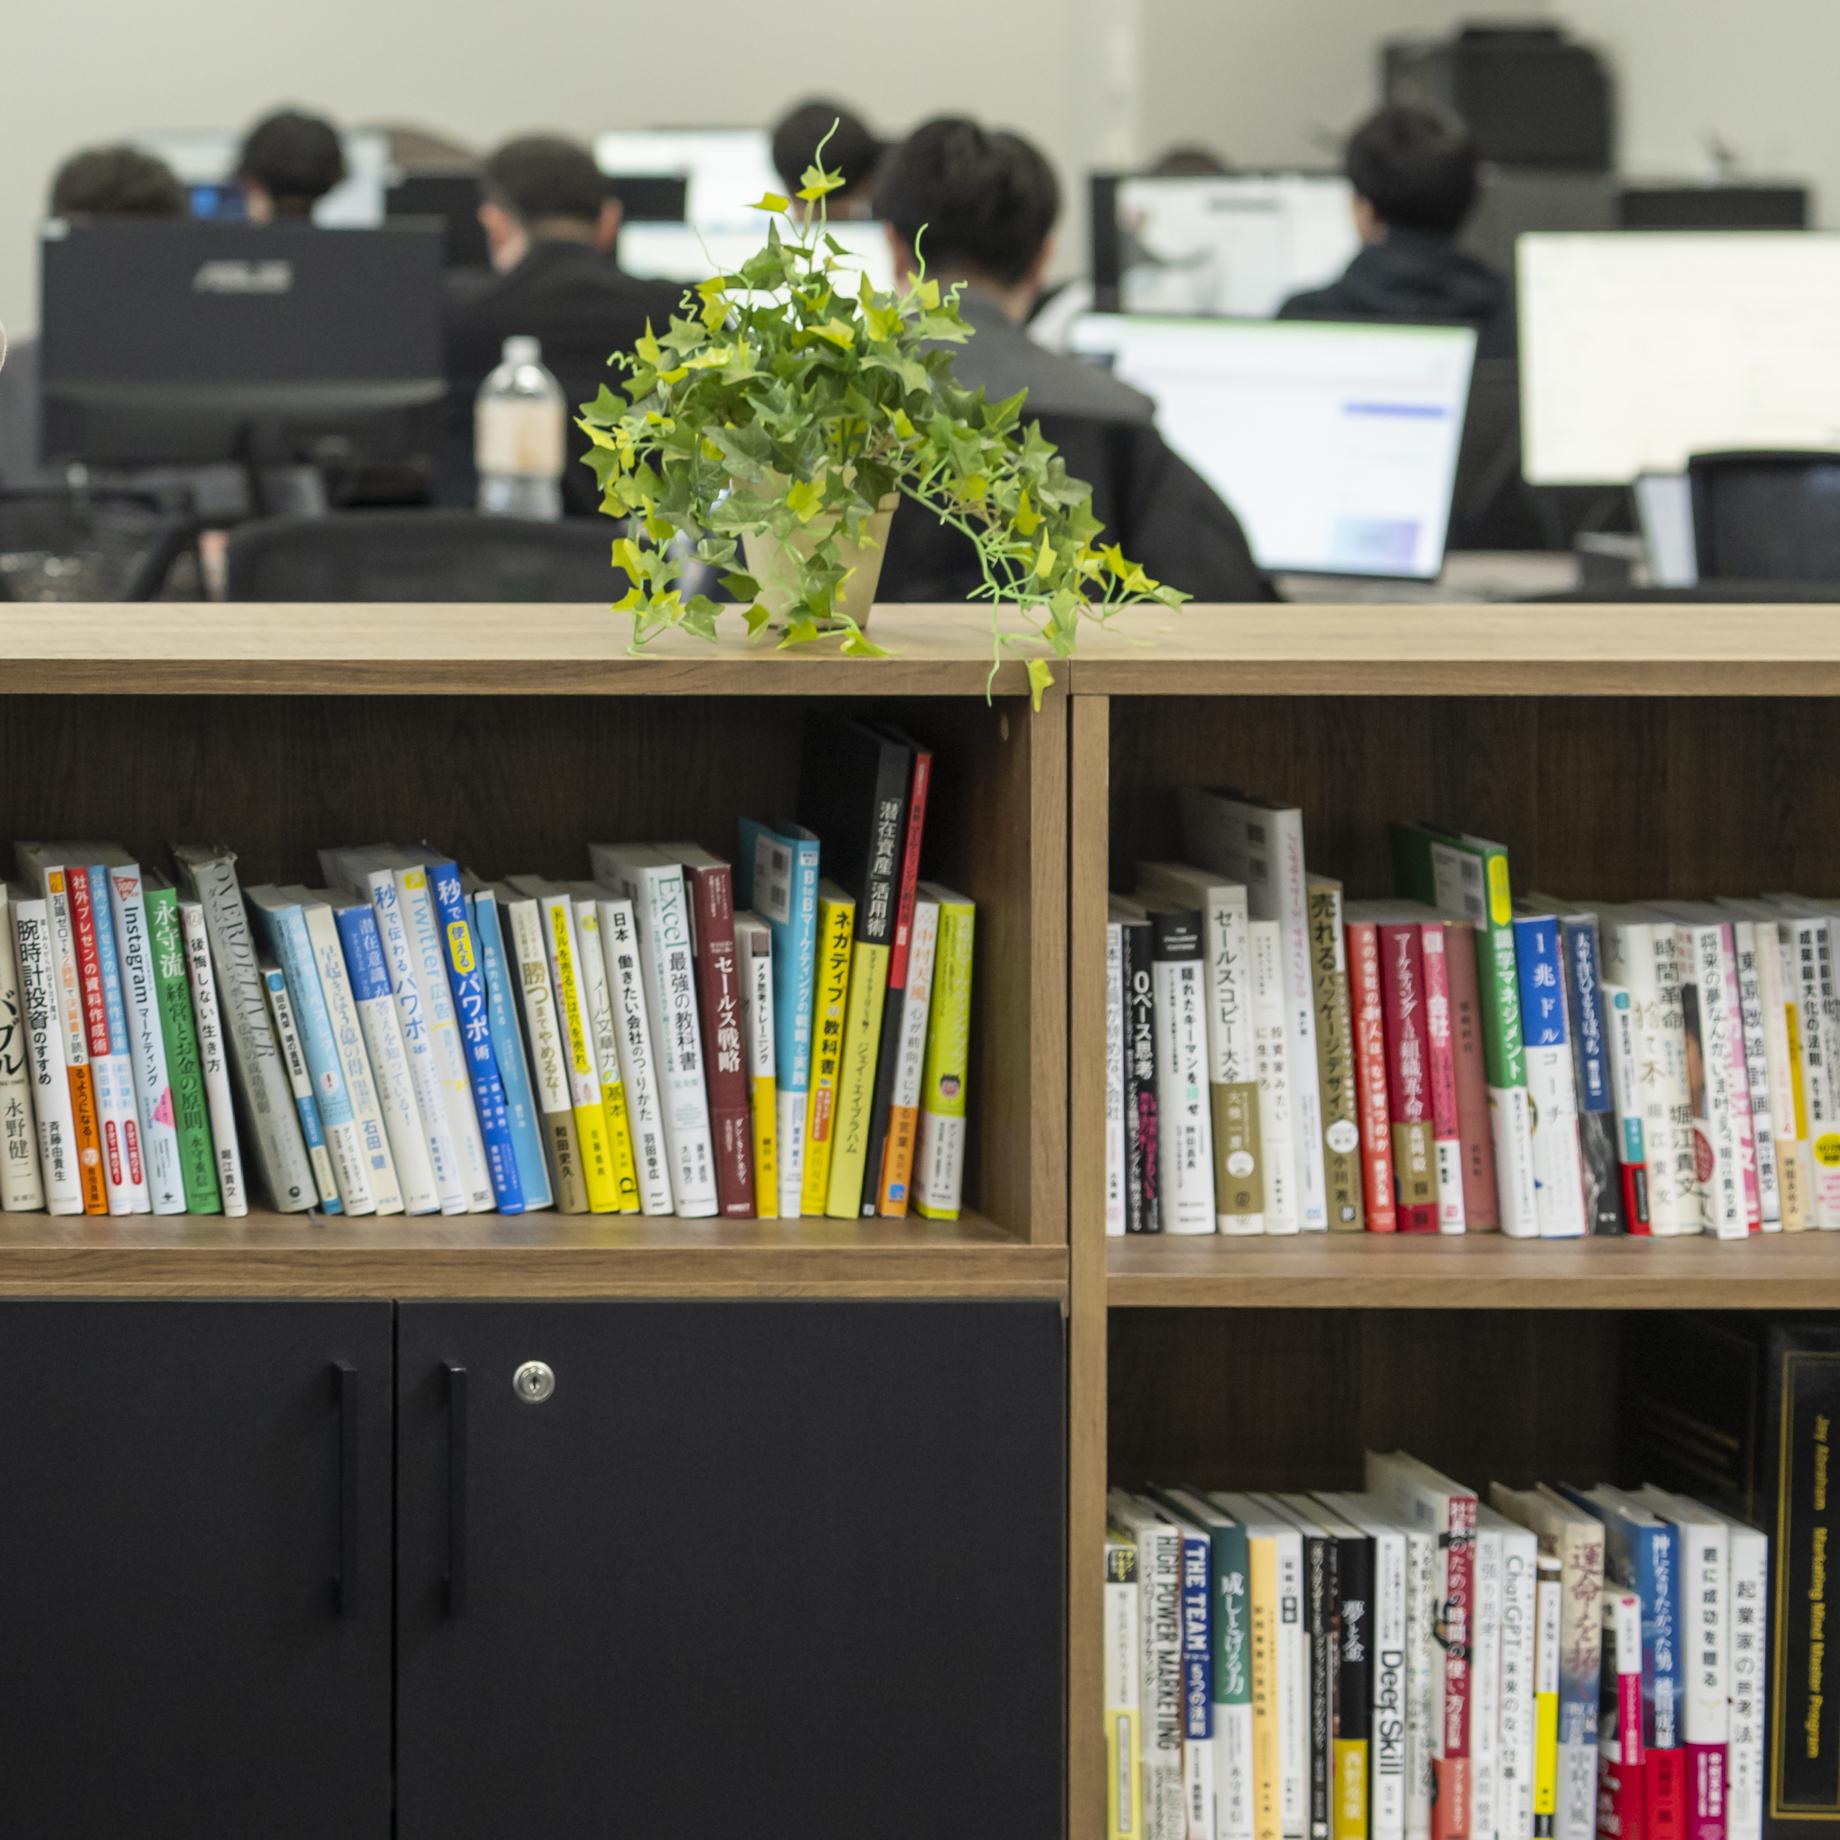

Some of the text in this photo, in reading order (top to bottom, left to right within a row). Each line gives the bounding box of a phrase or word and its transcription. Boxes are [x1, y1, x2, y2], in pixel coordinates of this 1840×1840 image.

[18, 919, 53, 1086] 腕時計投資のすすめ
[72, 875, 108, 1054] 社外プレゼンの資料作成術
[123, 906, 149, 1005] Instagram
[153, 899, 186, 979] 永守流
[190, 938, 221, 1074] 後悔しない生き方
[437, 878, 492, 1062] 秒で使えるパワポ術
[658, 875, 699, 1072] Excel 最強の教科書
[521, 961, 560, 1105] 勝つまでやめるな!
[714, 956, 742, 1073] セールス戦略
[1184, 1547, 1207, 1660] THE TEAM
[1377, 1650, 1405, 1776] Deep Skill
